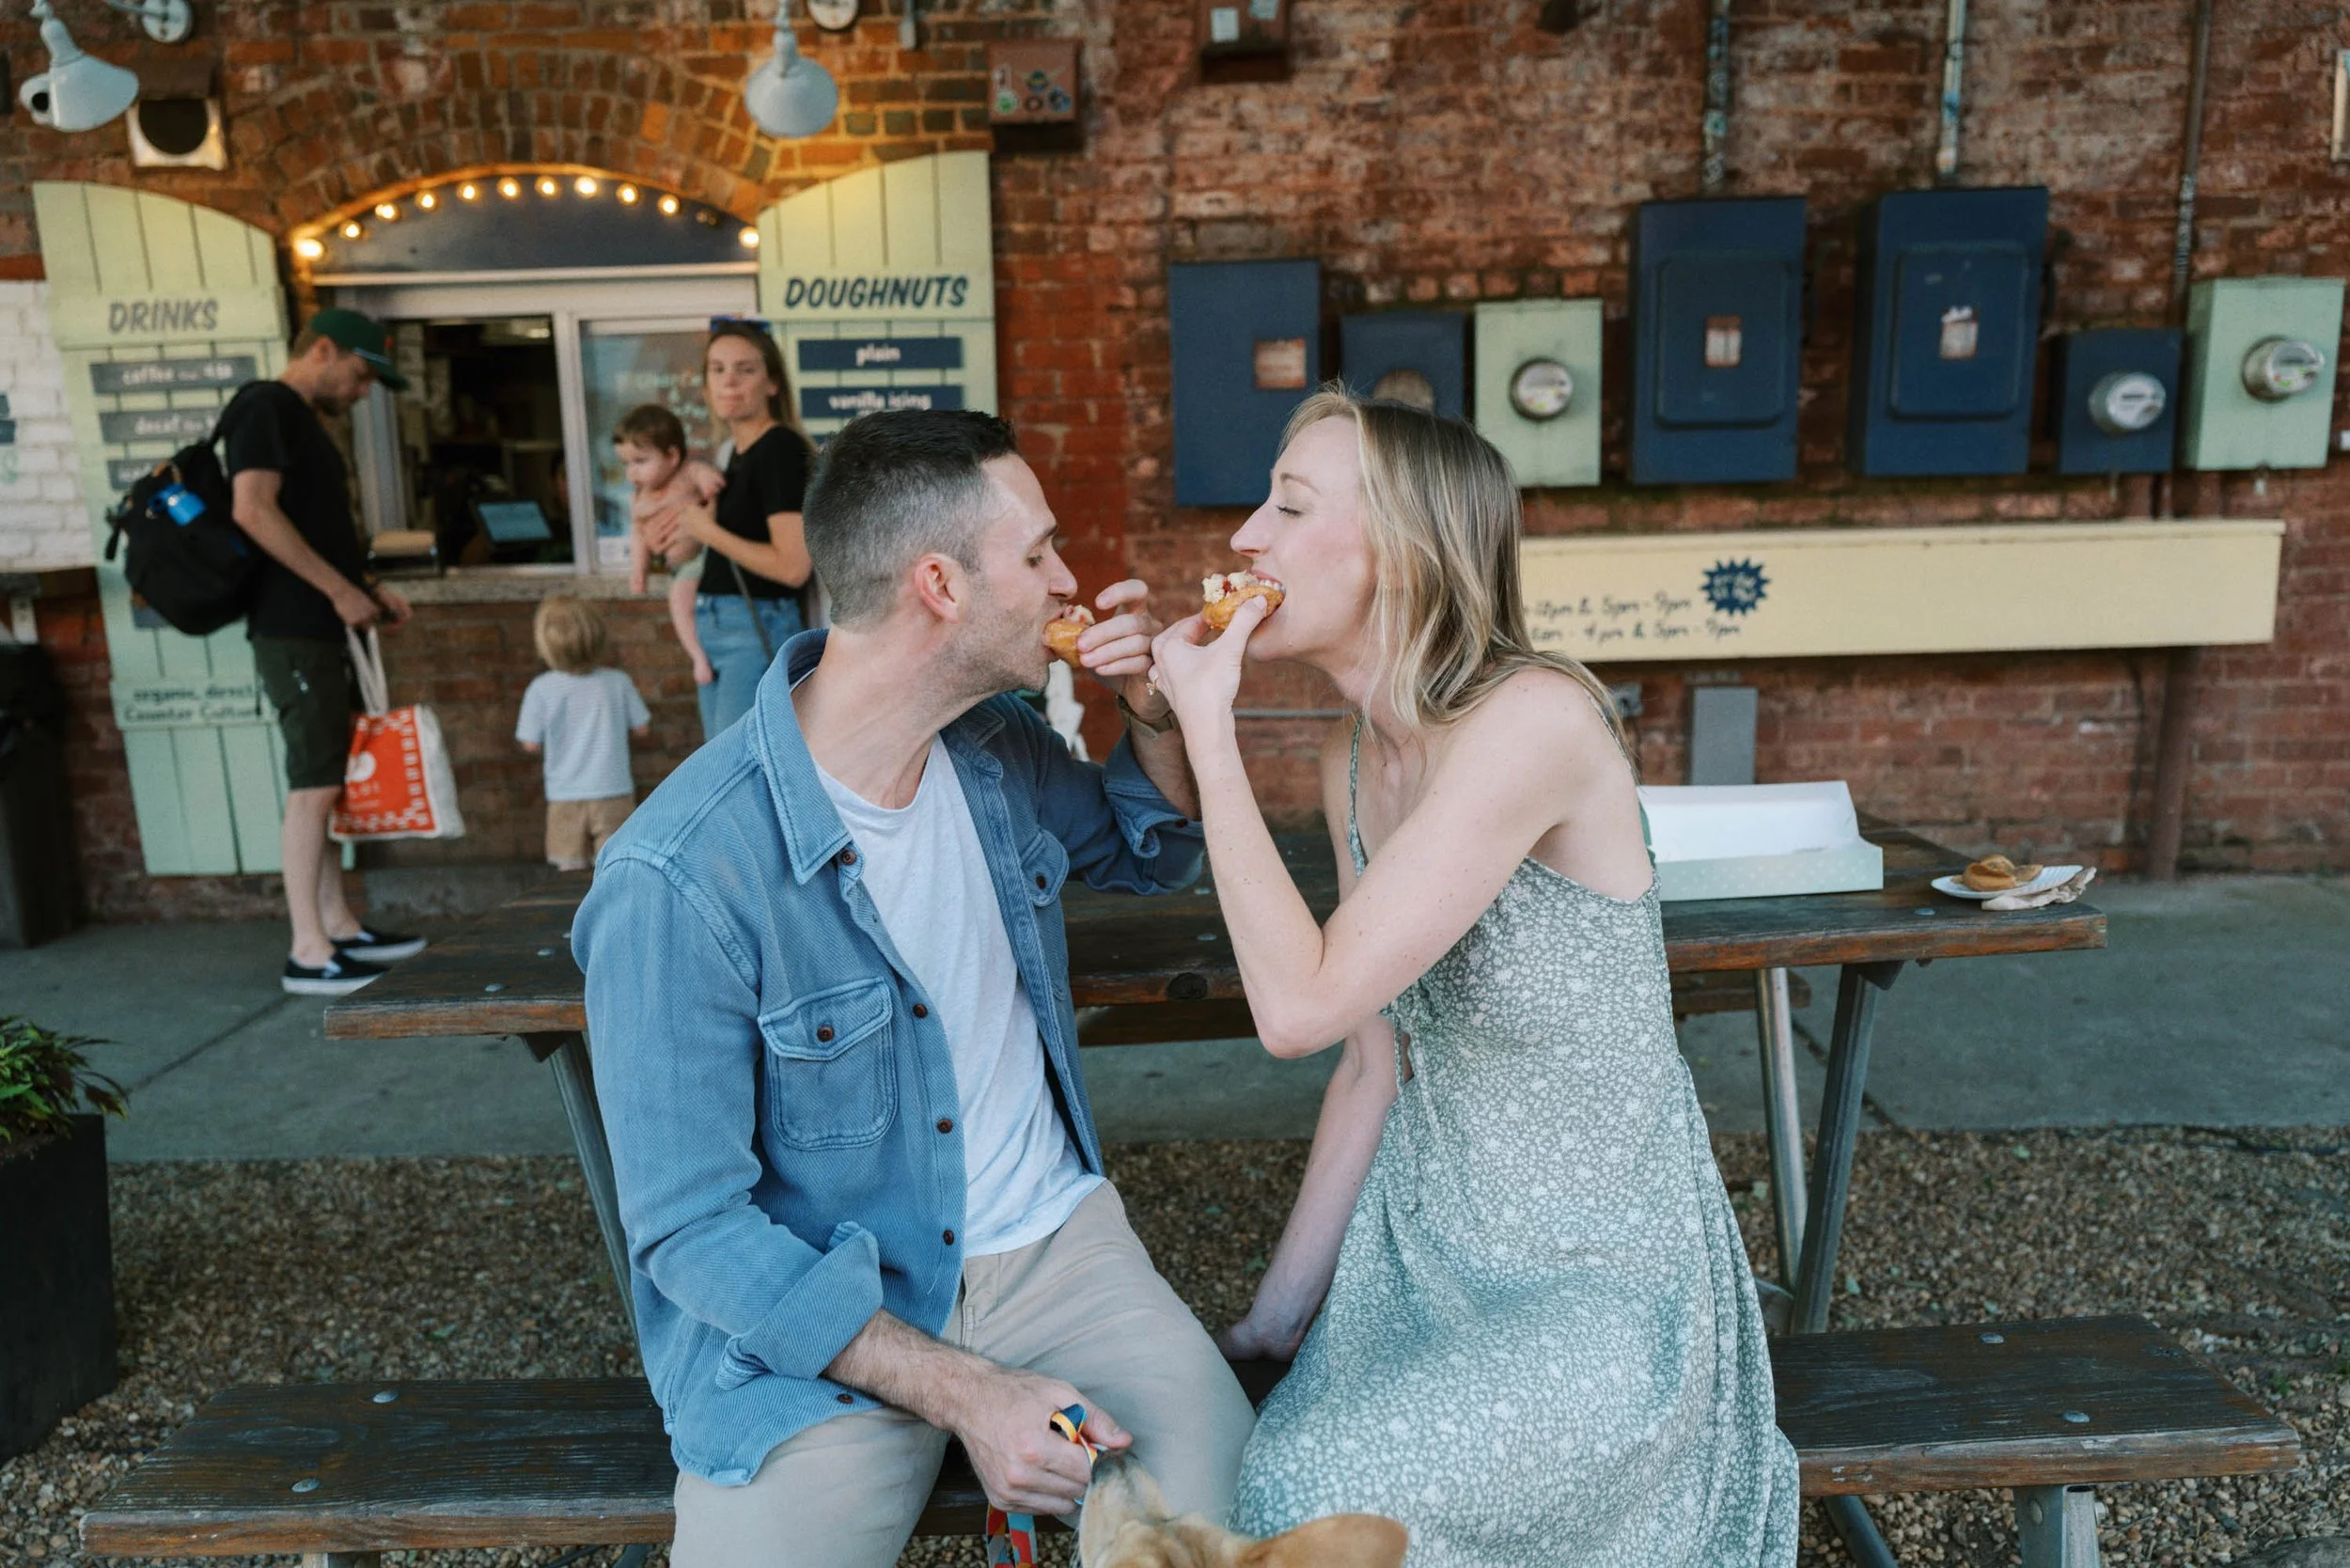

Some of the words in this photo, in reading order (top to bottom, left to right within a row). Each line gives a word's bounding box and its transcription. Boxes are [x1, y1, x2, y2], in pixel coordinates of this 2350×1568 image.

[784, 276, 969, 308] DOUGHNUTS
[108, 298, 219, 334] DRINKS
[855, 343, 901, 367] plain
[828, 390, 885, 410] vanilla
